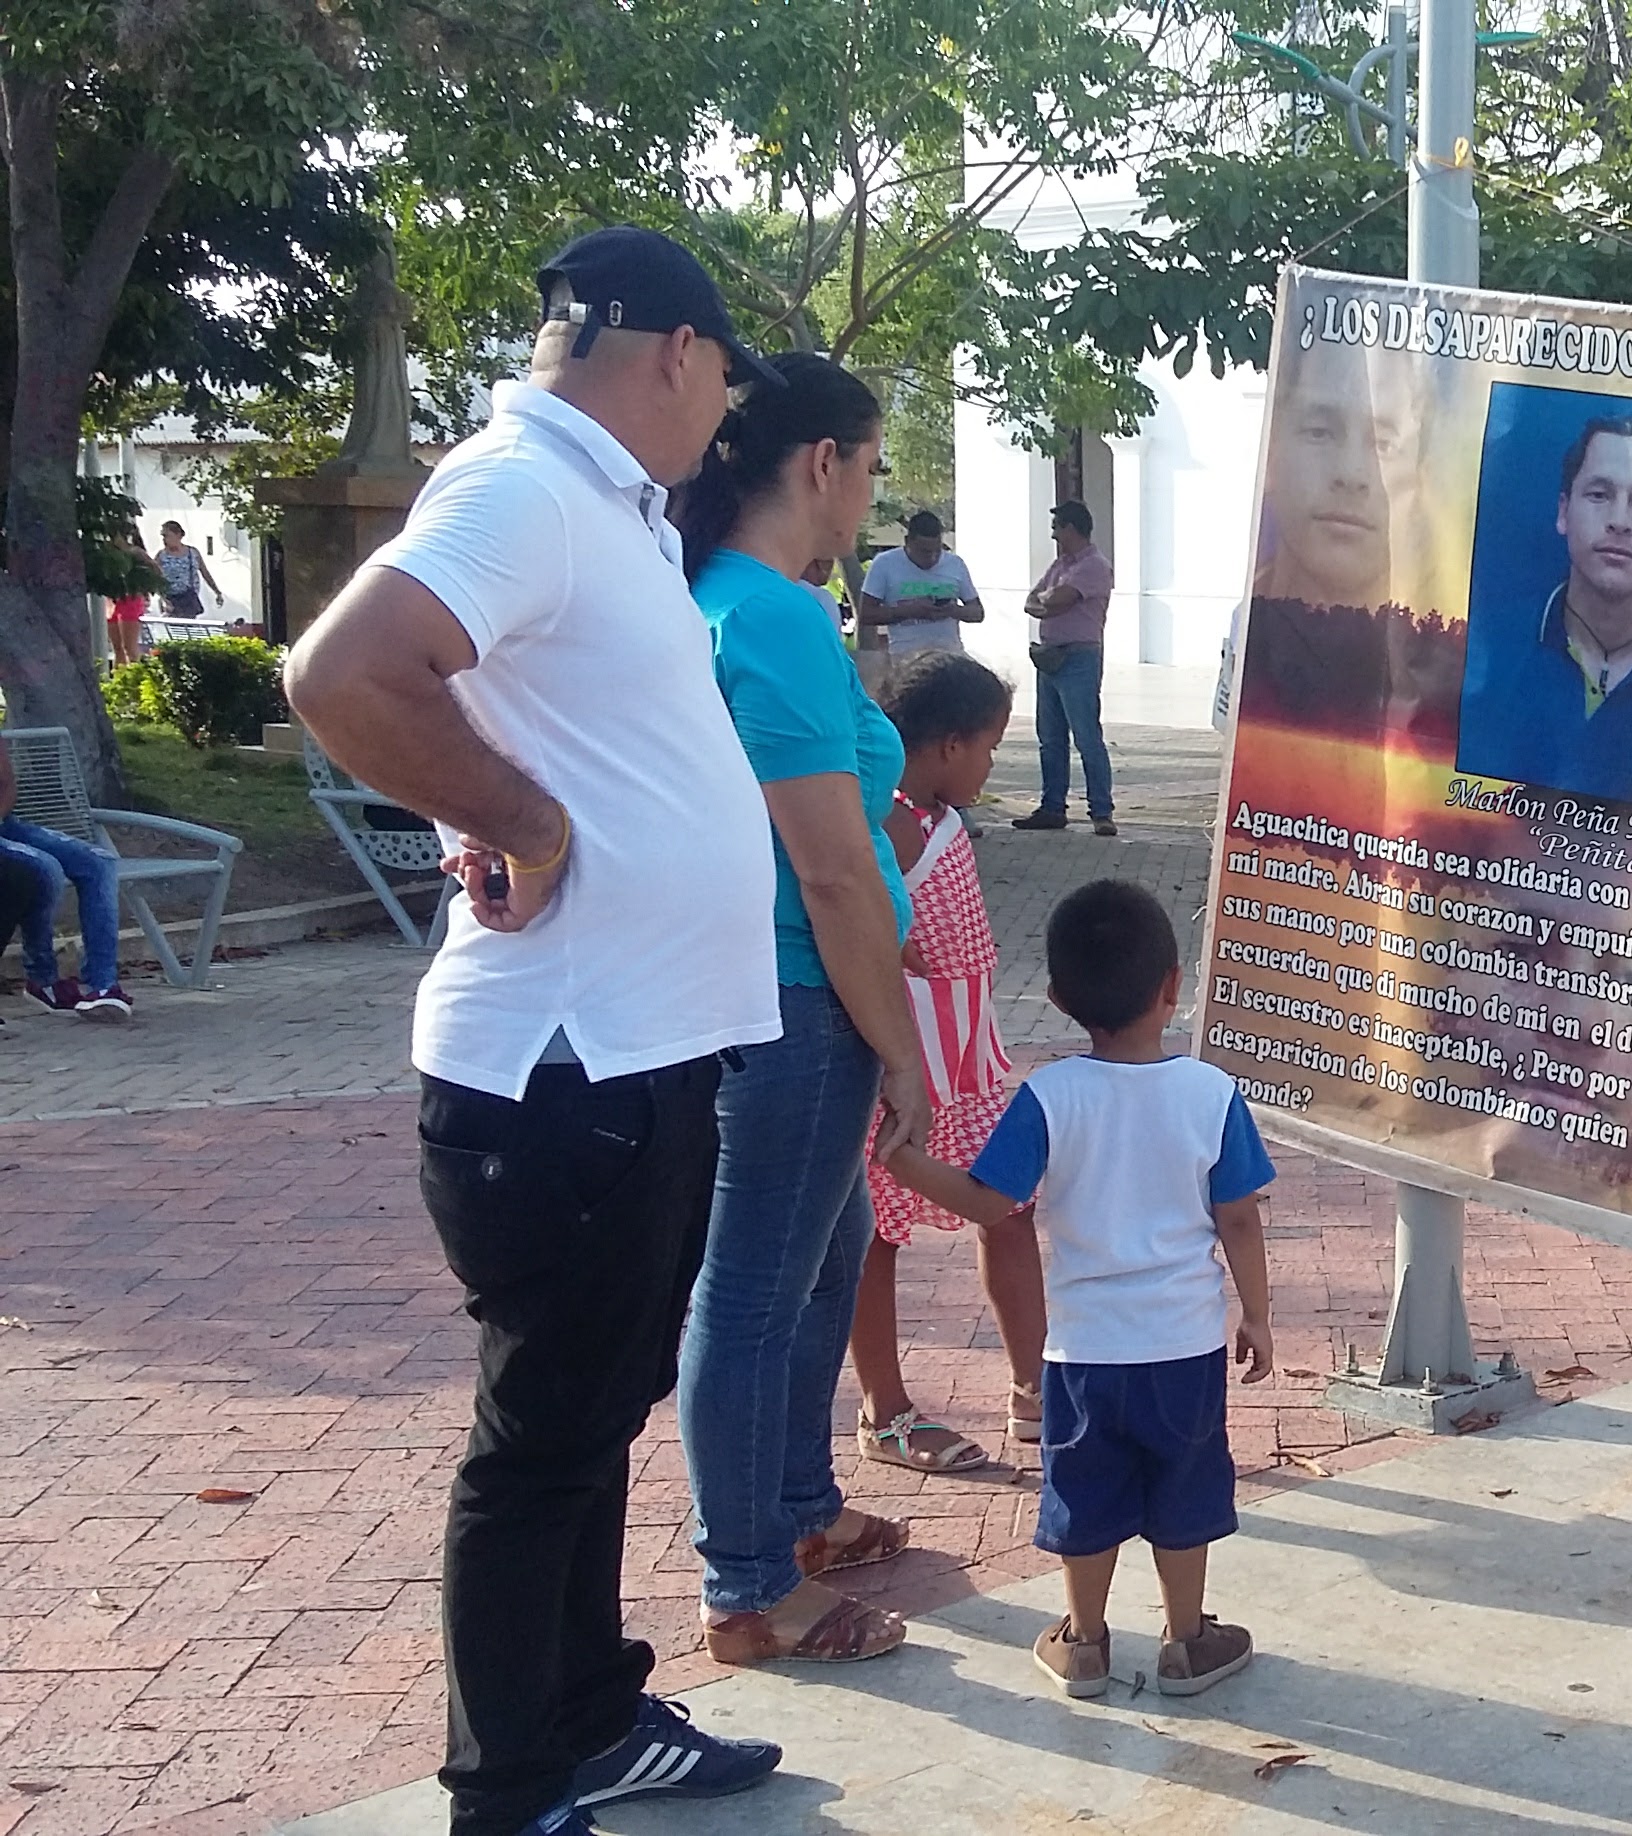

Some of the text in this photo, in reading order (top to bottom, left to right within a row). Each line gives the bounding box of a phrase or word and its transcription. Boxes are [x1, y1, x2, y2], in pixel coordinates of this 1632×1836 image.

[1322, 296, 1380, 347] LOS
[1231, 801, 1630, 909] Aguachica querida sea solidaria con
[1445, 779, 1546, 821] Marlon
[1553, 799, 1620, 835] Peña
[1222, 895, 1261, 921] sus
[1265, 902, 1336, 938] manos
[1339, 921, 1376, 947] por
[1380, 930, 1416, 959] una
[1421, 940, 1529, 982] colombia
[1227, 849, 1259, 875] mi
[1263, 859, 1339, 893] madre.
[1344, 869, 1404, 911] Abran
[1408, 892, 1435, 916] su
[1439, 898, 1533, 937] corazon
[1537, 918, 1556, 946] y
[1213, 975, 1238, 1006] El
[1242, 987, 1344, 1031] secuestro
[1348, 1016, 1370, 1037] es
[1373, 1013, 1508, 1076] inaceptable,
[1530, 1049, 1584, 1089] Pero
[1587, 1071, 1630, 1100] por
[1217, 938, 1330, 982] recuerden
[1335, 964, 1373, 993] que
[1376, 970, 1395, 999] di
[1398, 981, 1477, 1017] mucho
[1482, 995, 1511, 1024] de
[1515, 1004, 1548, 1033] mi
[1552, 1017, 1580, 1041] en
[1590, 1020, 1614, 1049] el
[1208, 1021, 1628, 1149] desaparicion de los colombianos quien
[1228, 1074, 1313, 1113] ponde?
